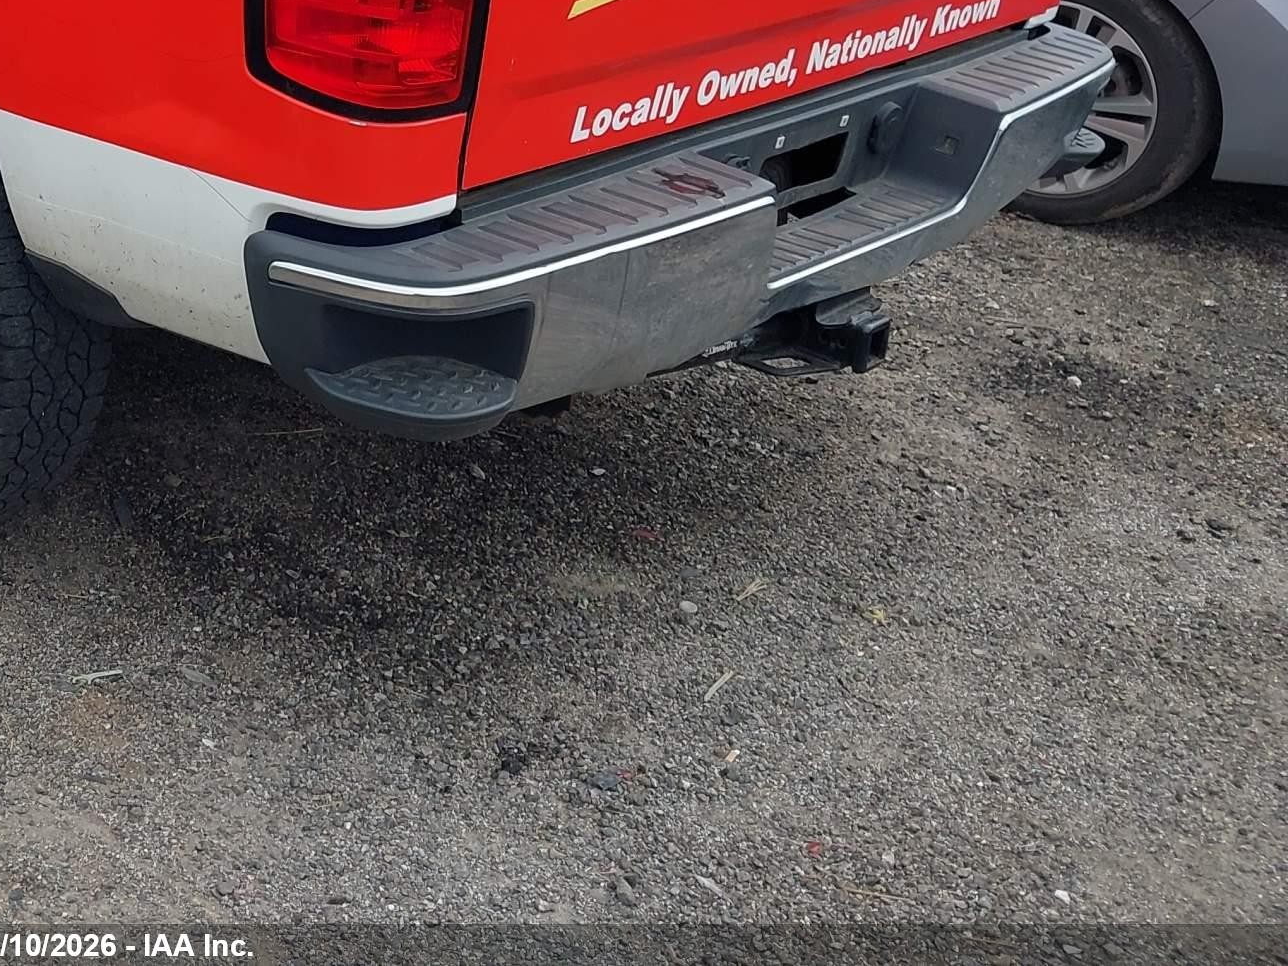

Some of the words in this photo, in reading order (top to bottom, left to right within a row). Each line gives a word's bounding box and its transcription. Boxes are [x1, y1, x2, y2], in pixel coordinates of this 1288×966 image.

[570, 84, 691, 144] Locally
[696, 49, 797, 108] Owned,
[805, 17, 927, 75] Nationally
